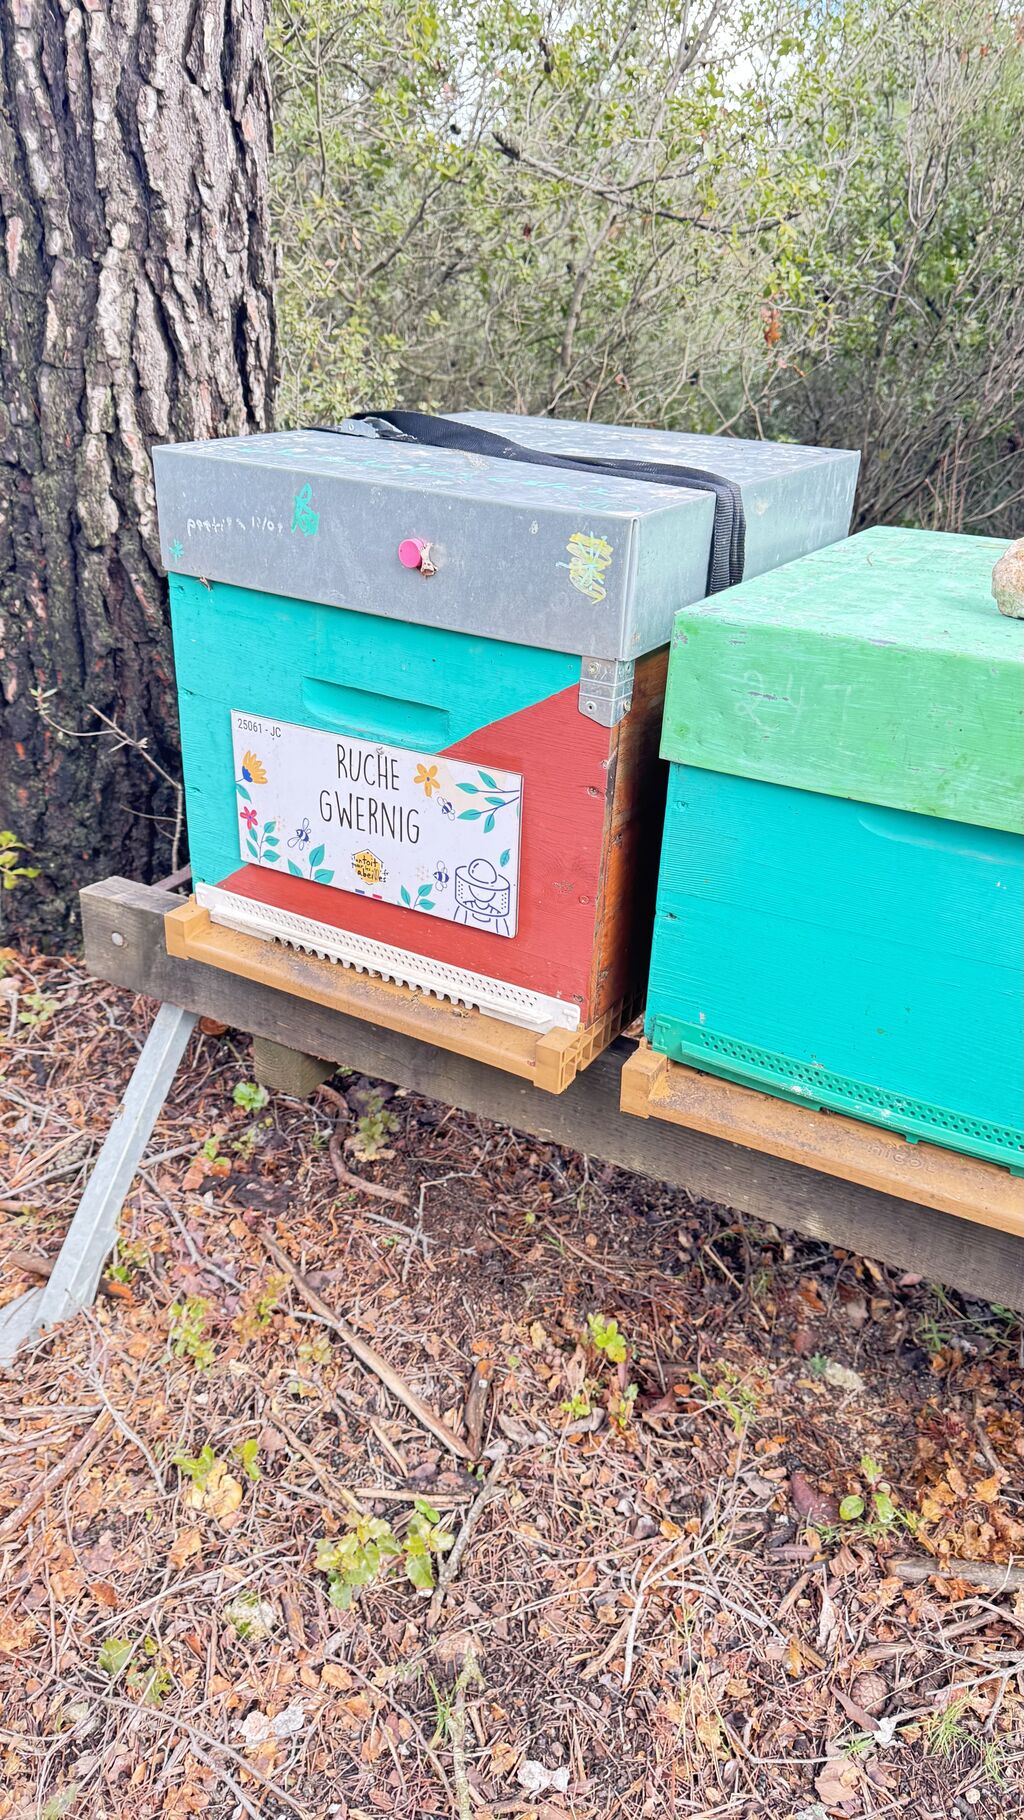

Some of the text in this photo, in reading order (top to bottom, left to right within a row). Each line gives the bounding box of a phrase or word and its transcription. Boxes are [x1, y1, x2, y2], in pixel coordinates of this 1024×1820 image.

[237, 718, 263, 734] 25061
[270, 726, 282, 738] JC
[336, 743, 400, 791] RUCHE
[320, 789, 420, 844] GWERNIG
